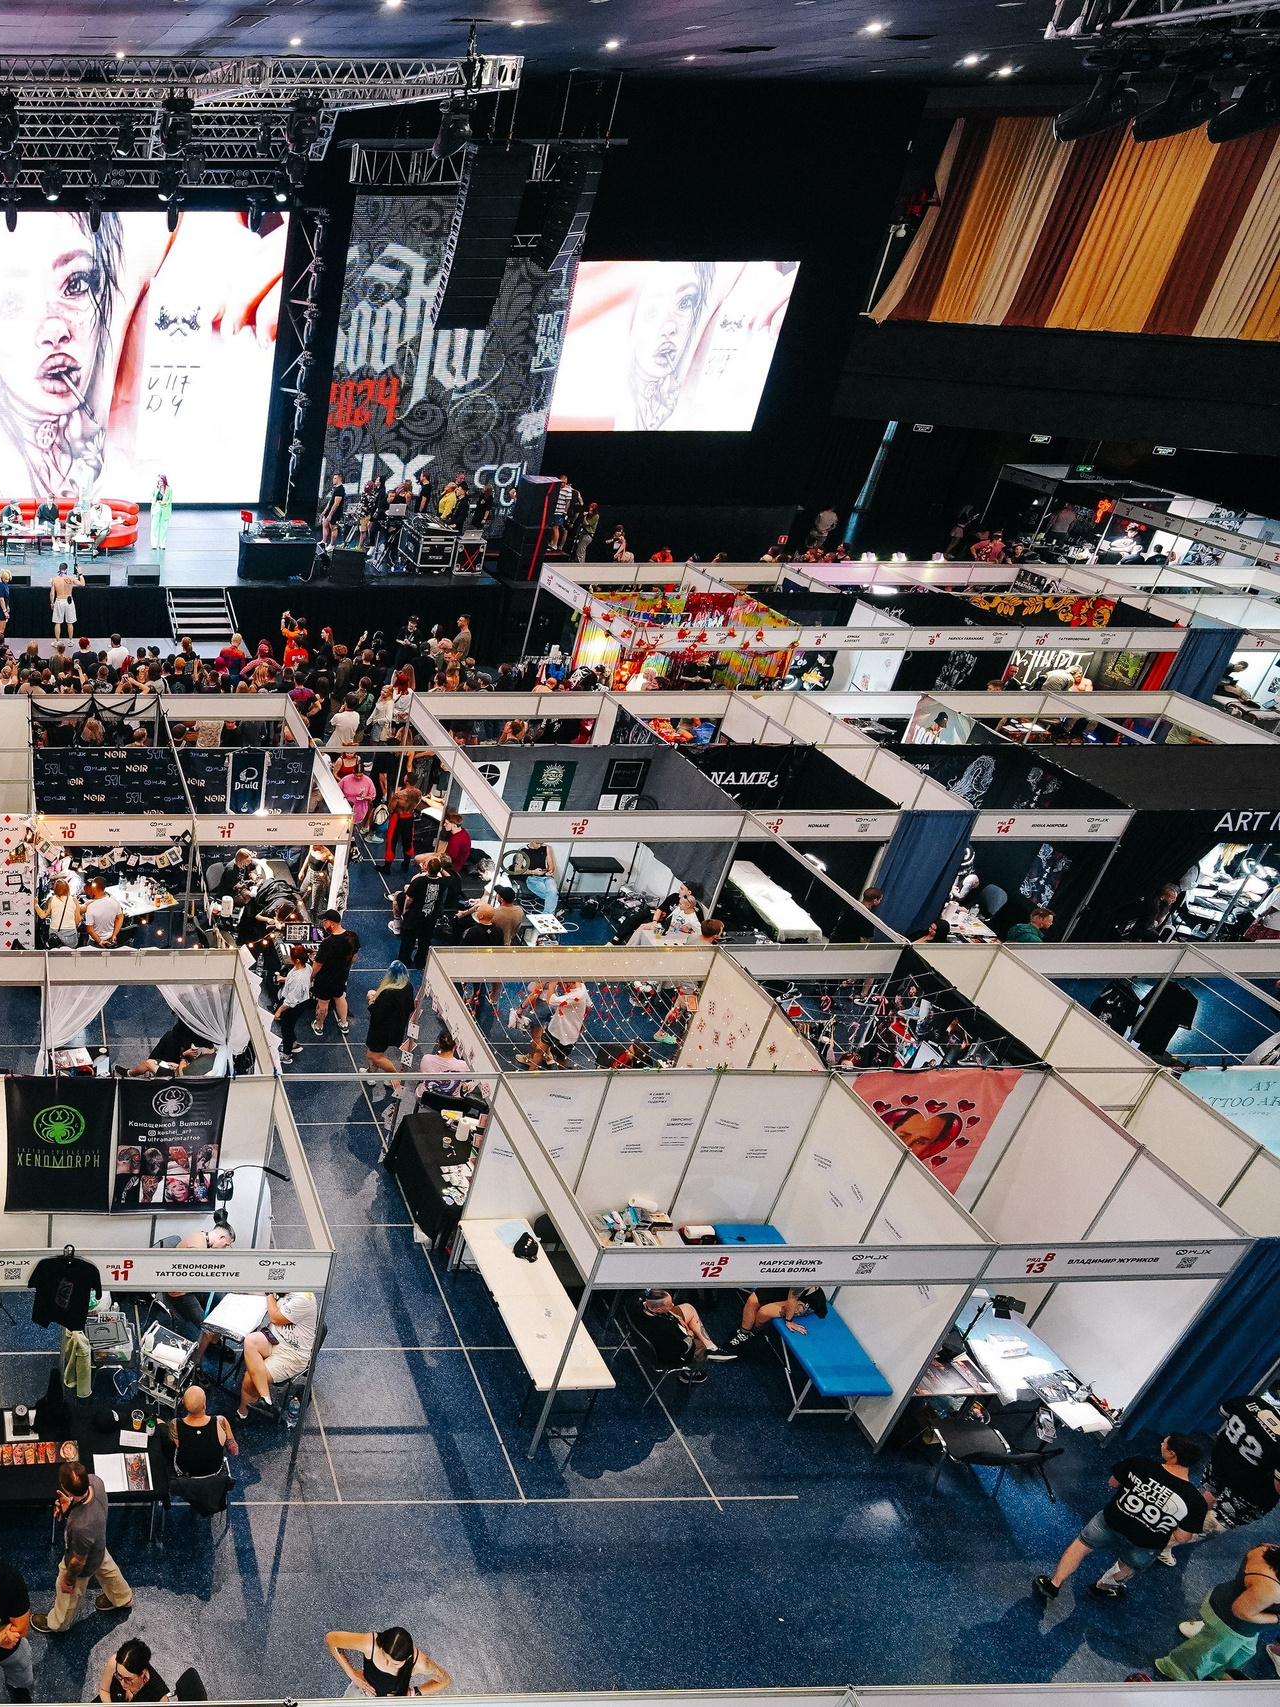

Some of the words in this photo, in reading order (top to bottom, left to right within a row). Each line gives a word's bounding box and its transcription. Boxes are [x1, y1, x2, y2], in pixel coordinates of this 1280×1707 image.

[928, 638, 935, 646] 9
[104, 750, 127, 759] NOIR
[125, 764, 149, 773] NOIR
[541, 772, 564, 780] APOLLO
[83, 793, 106, 802] NOIR
[1214, 812, 1266, 832] ART
[571, 826, 585, 835] 12
[996, 825, 1011, 834] 14
[61, 830, 75, 839] 10
[220, 830, 232, 839] 11
[1247, 1081, 1277, 1092] AY
[128, 1120, 176, 1129] Канащенков
[179, 1119, 213, 1127] Виталий
[16, 1153, 100, 1168] XENOMORPH
[795, 1258, 823, 1266] ЙОЖЪ
[106, 1263, 122, 1271] РЯД
[1025, 1262, 1047, 1274] 13
[112, 1269, 130, 1282] 11
[155, 1270, 186, 1278] TATTOO
[187, 1270, 241, 1278] COLLECTIVE
[701, 1266, 723, 1278] 12
[1148, 1477, 1174, 1498] THE
[1119, 1486, 1178, 1532] 1992
